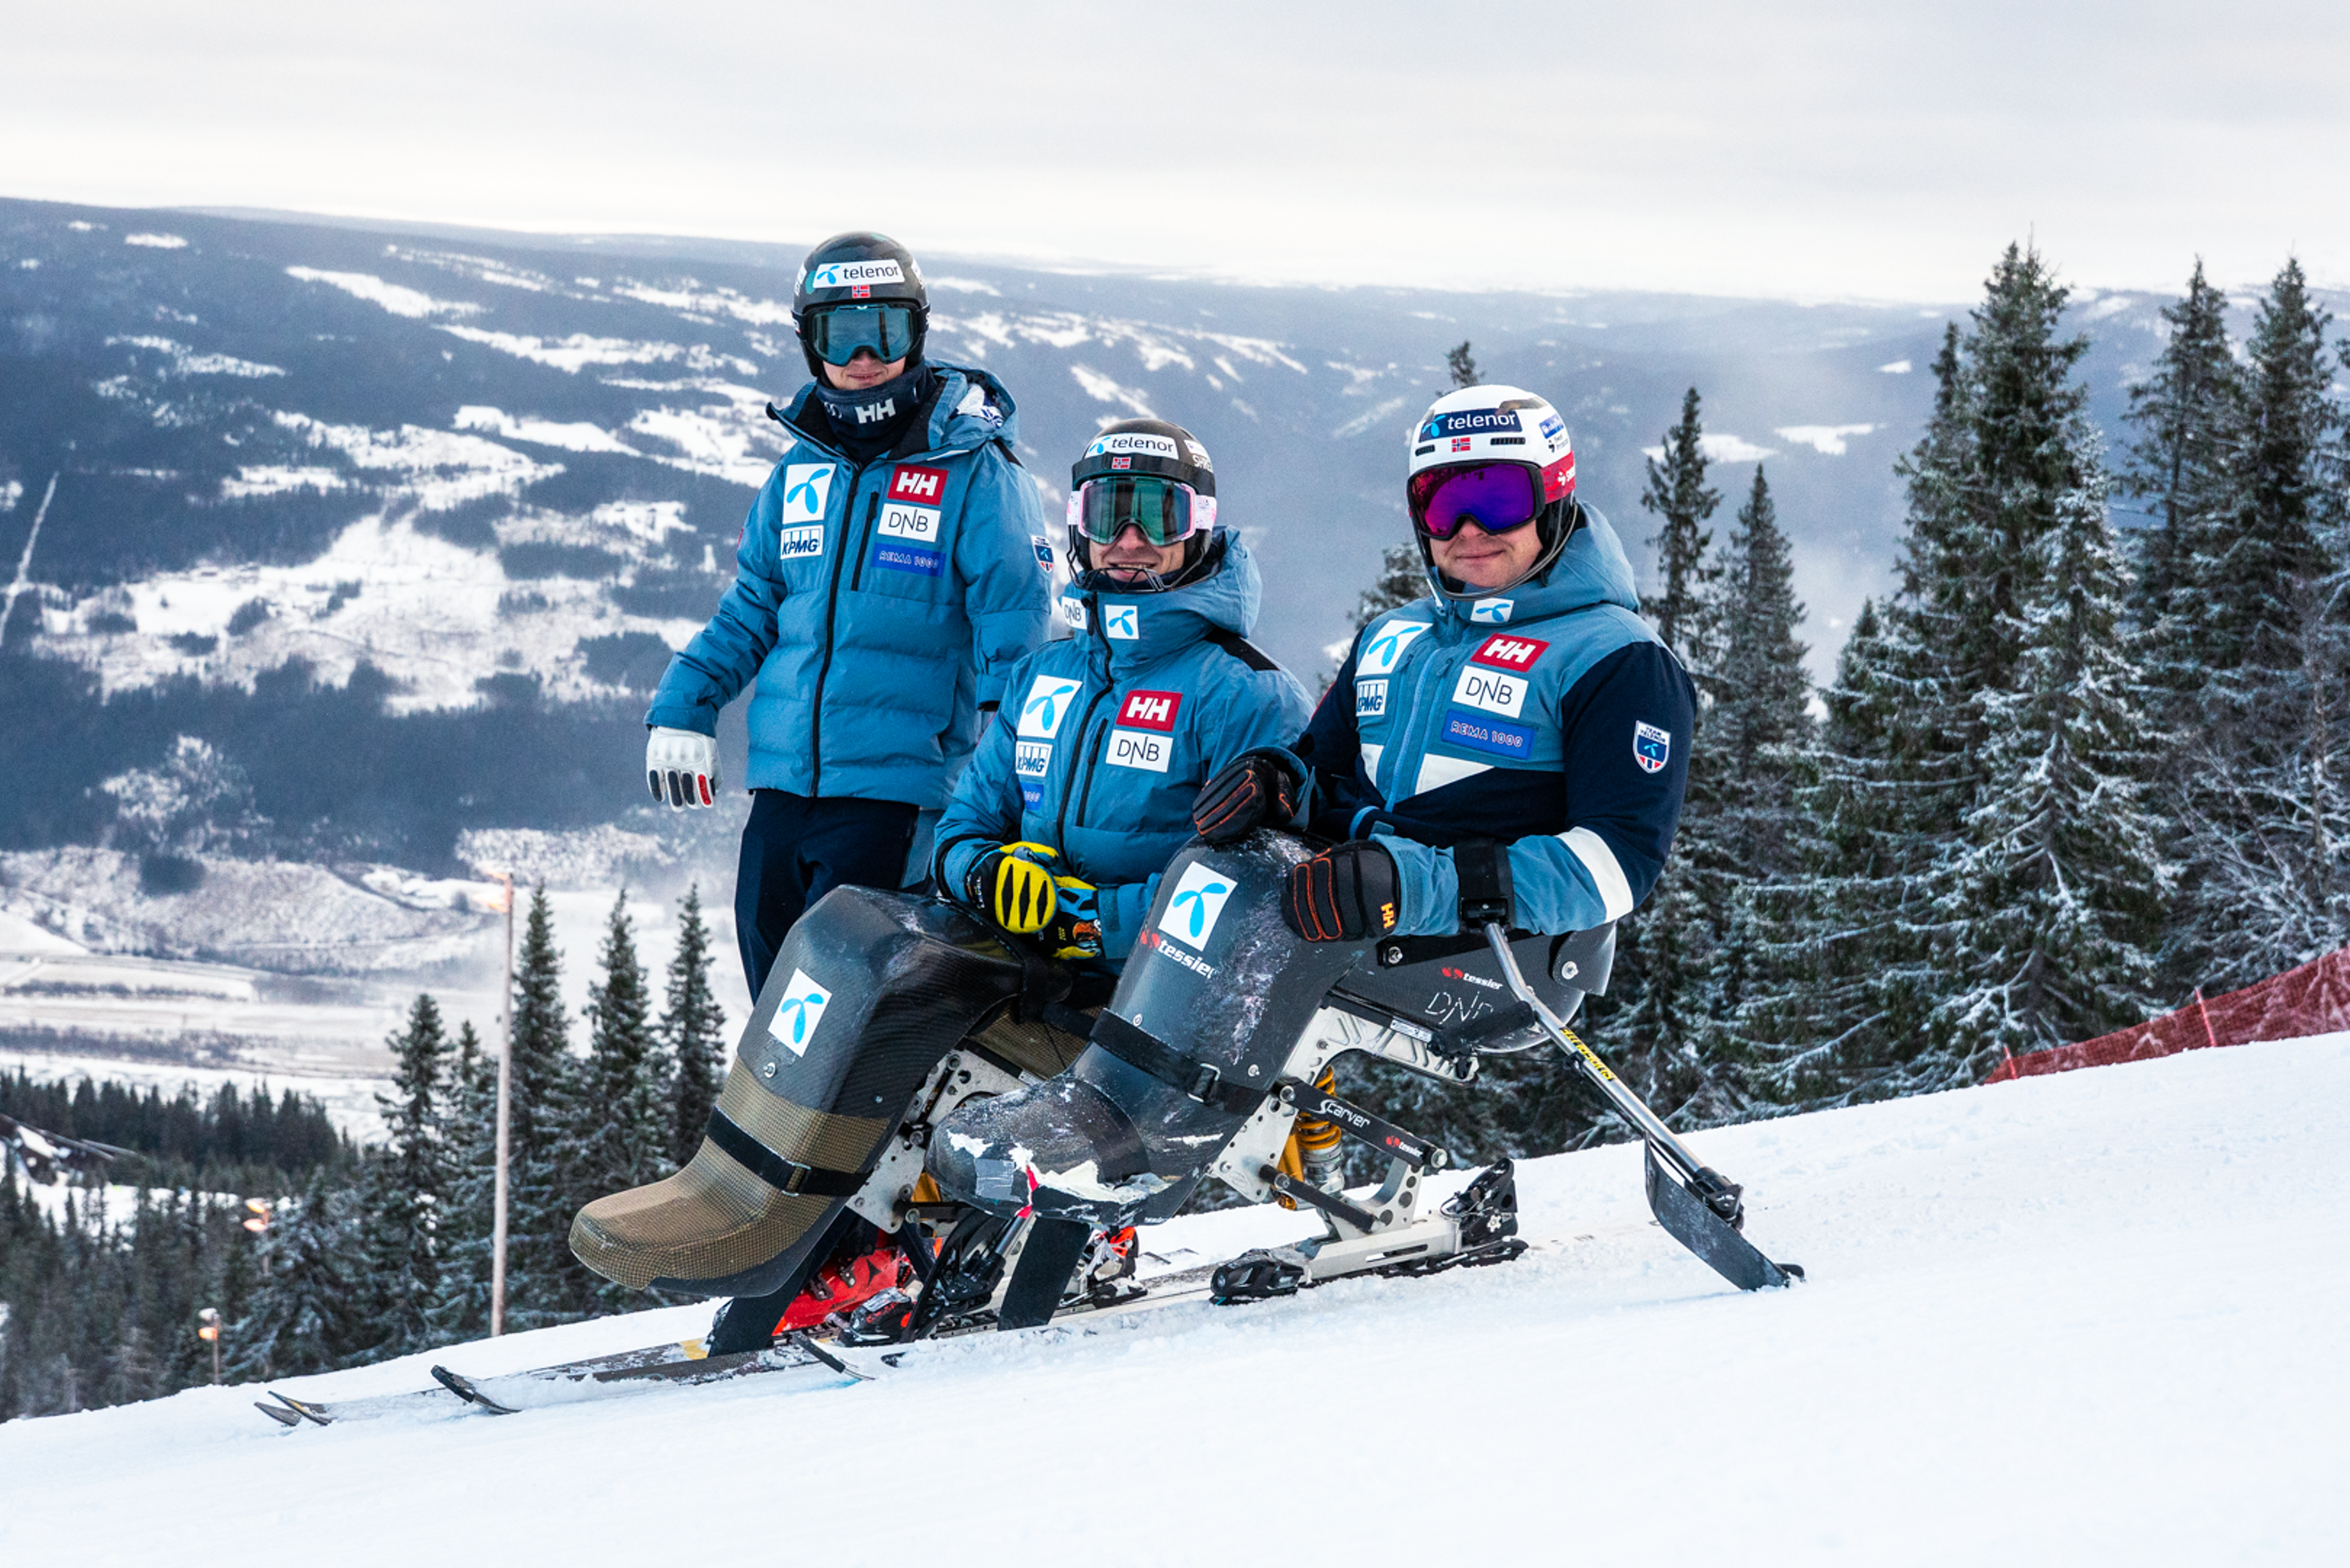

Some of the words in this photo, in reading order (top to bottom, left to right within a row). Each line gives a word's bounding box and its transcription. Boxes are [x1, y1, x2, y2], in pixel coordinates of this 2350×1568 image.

[843, 265, 899, 280] telenor
[854, 398, 897, 424] HH
[1447, 414, 1516, 430] telenor
[1111, 436, 1174, 452] telenor
[896, 471, 939, 496] HH
[888, 509, 928, 535] DNB
[781, 539, 819, 555] KPMG
[879, 550, 912, 565] REMA
[914, 556, 939, 569] 1000
[1483, 638, 1537, 664] HH
[1466, 676, 1513, 706] DNB
[1126, 696, 1172, 722] HH
[1450, 720, 1488, 741] REMA
[1491, 731, 1523, 748] 1000
[1117, 736, 1160, 765] DNB
[1380, 902, 1395, 929] HH
[1158, 939, 1219, 979] tessier
[1463, 973, 1504, 990] tessier
[1307, 1099, 1371, 1128] Scarver
